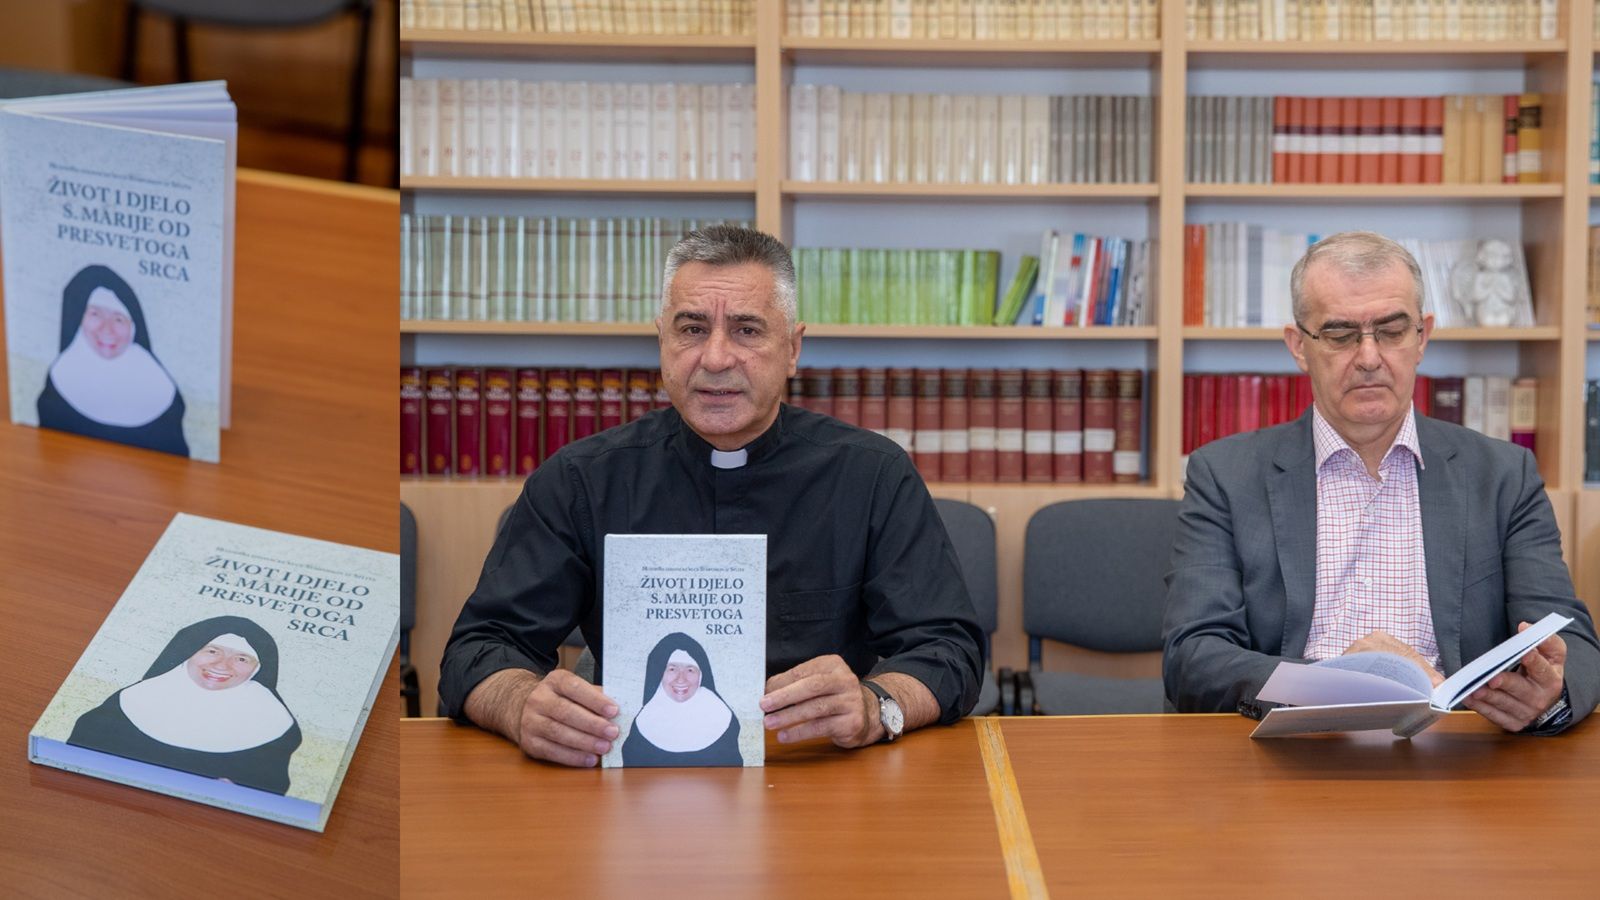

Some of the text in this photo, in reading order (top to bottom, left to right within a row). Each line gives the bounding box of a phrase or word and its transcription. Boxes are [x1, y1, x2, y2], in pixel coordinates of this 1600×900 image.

[48, 175, 110, 203] ŽIVOT
[115, 189, 122, 205] I
[127, 191, 191, 216] DJELO
[62, 203, 191, 238] S. MARIJE OD
[57, 223, 190, 260] PRESVETOGA
[138, 259, 190, 282] SRCA
[205, 555, 280, 579] ŽIVOT
[283, 571, 291, 582] I
[296, 574, 370, 597] DJELO
[640, 575, 744, 592] ŽIVOT I DJELO
[198, 584, 356, 627] PRESVETOGA
[213, 573, 364, 611] S. MARIJE OD
[651, 593, 744, 607] S. MARIJE OD
[645, 608, 743, 620] PRESVETOGA
[287, 619, 350, 642] SRCA
[706, 624, 743, 635] SRCA
